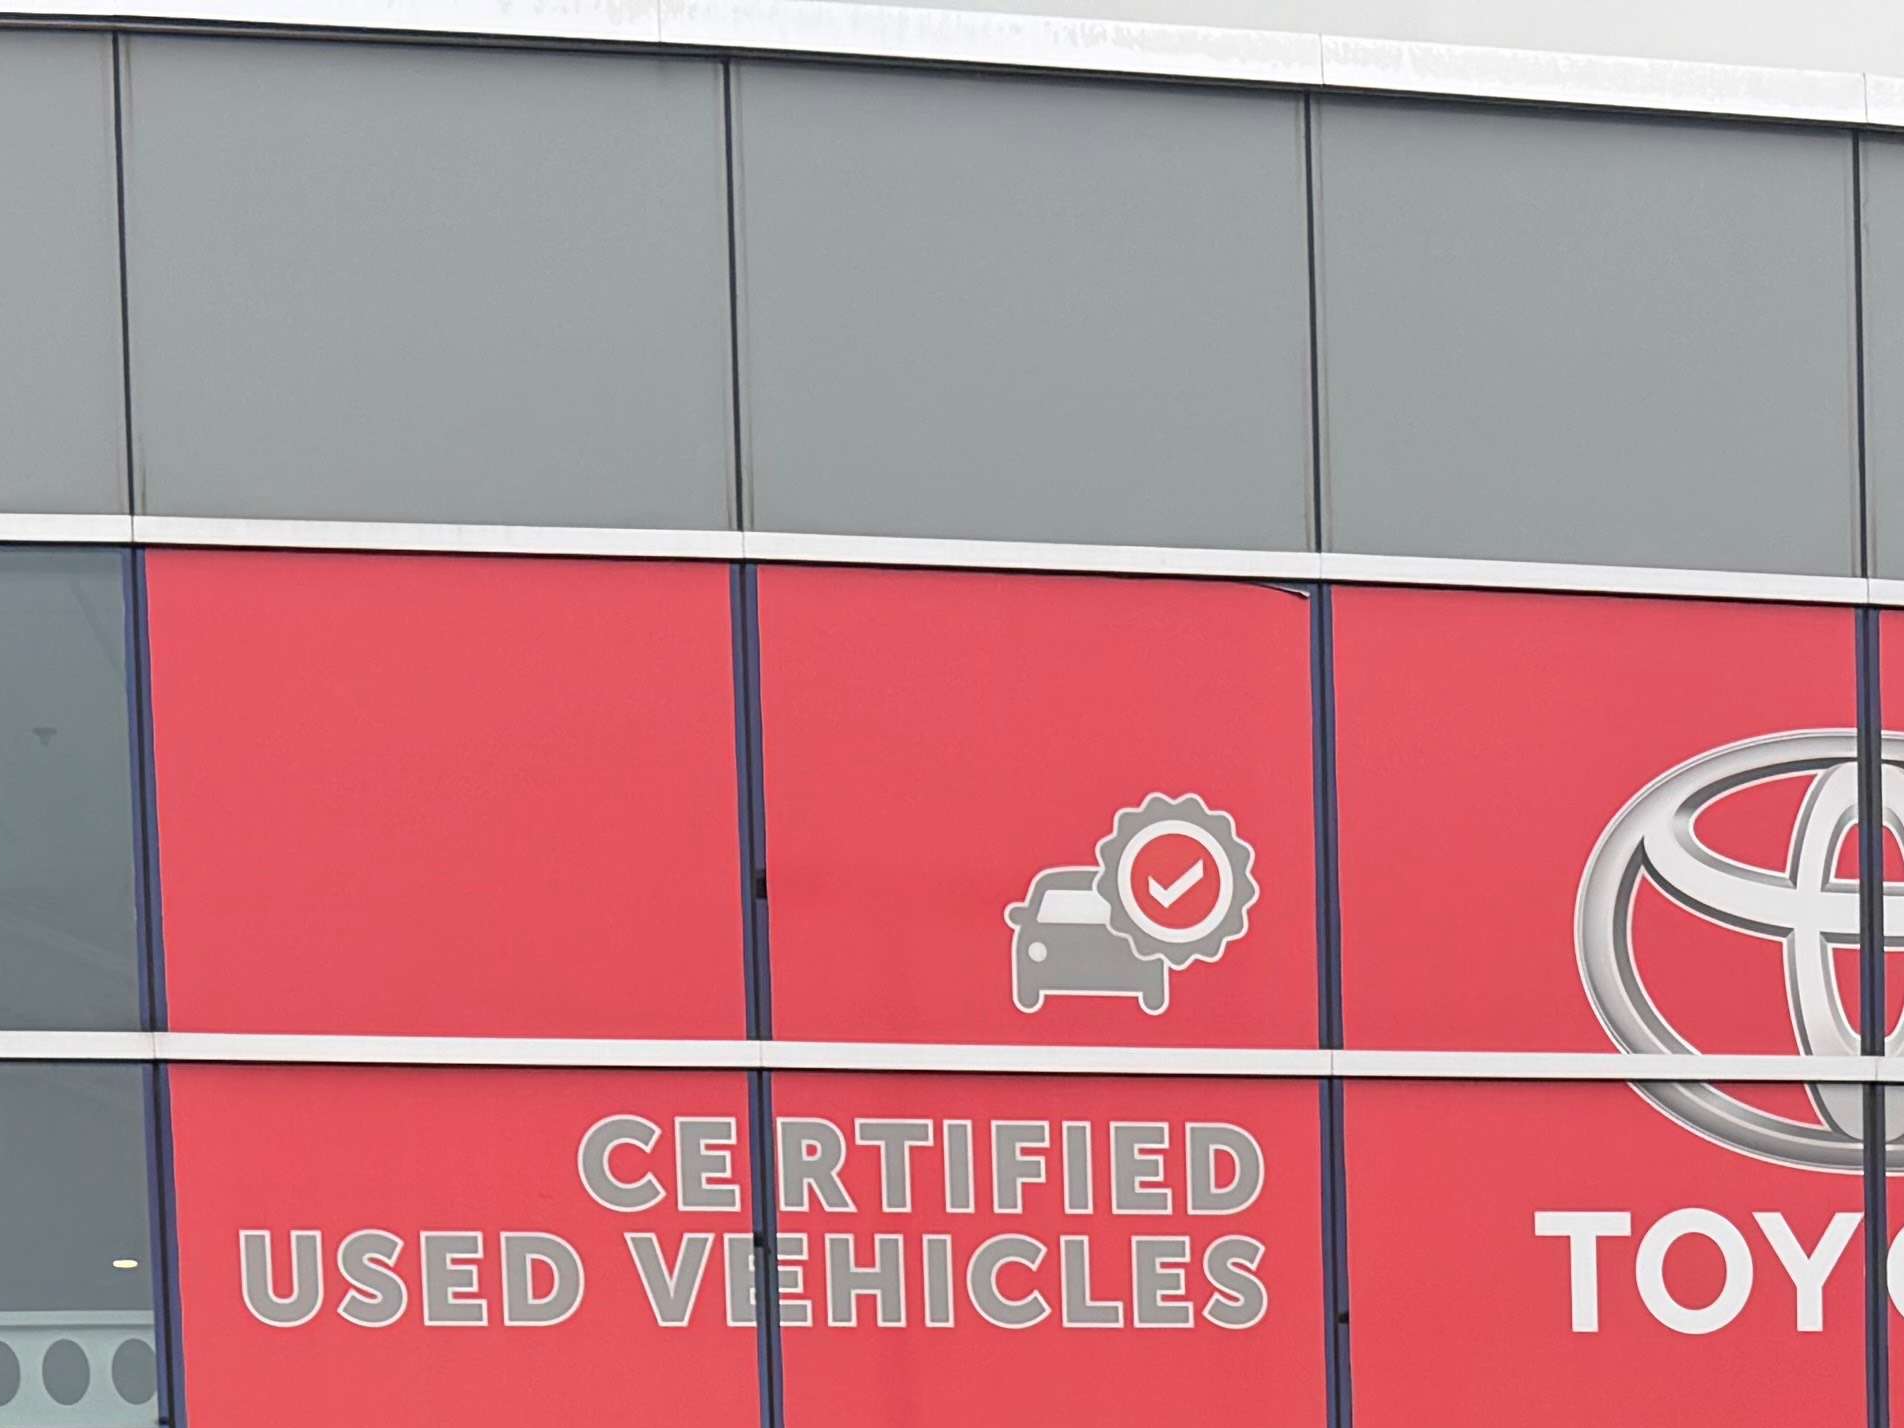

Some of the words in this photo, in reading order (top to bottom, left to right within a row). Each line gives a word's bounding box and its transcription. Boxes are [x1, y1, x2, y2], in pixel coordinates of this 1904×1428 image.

[576, 1113, 1267, 1217] CERTIFIED
[238, 1228, 587, 1328] USED
[624, 1232, 1270, 1331] VEHICLES
